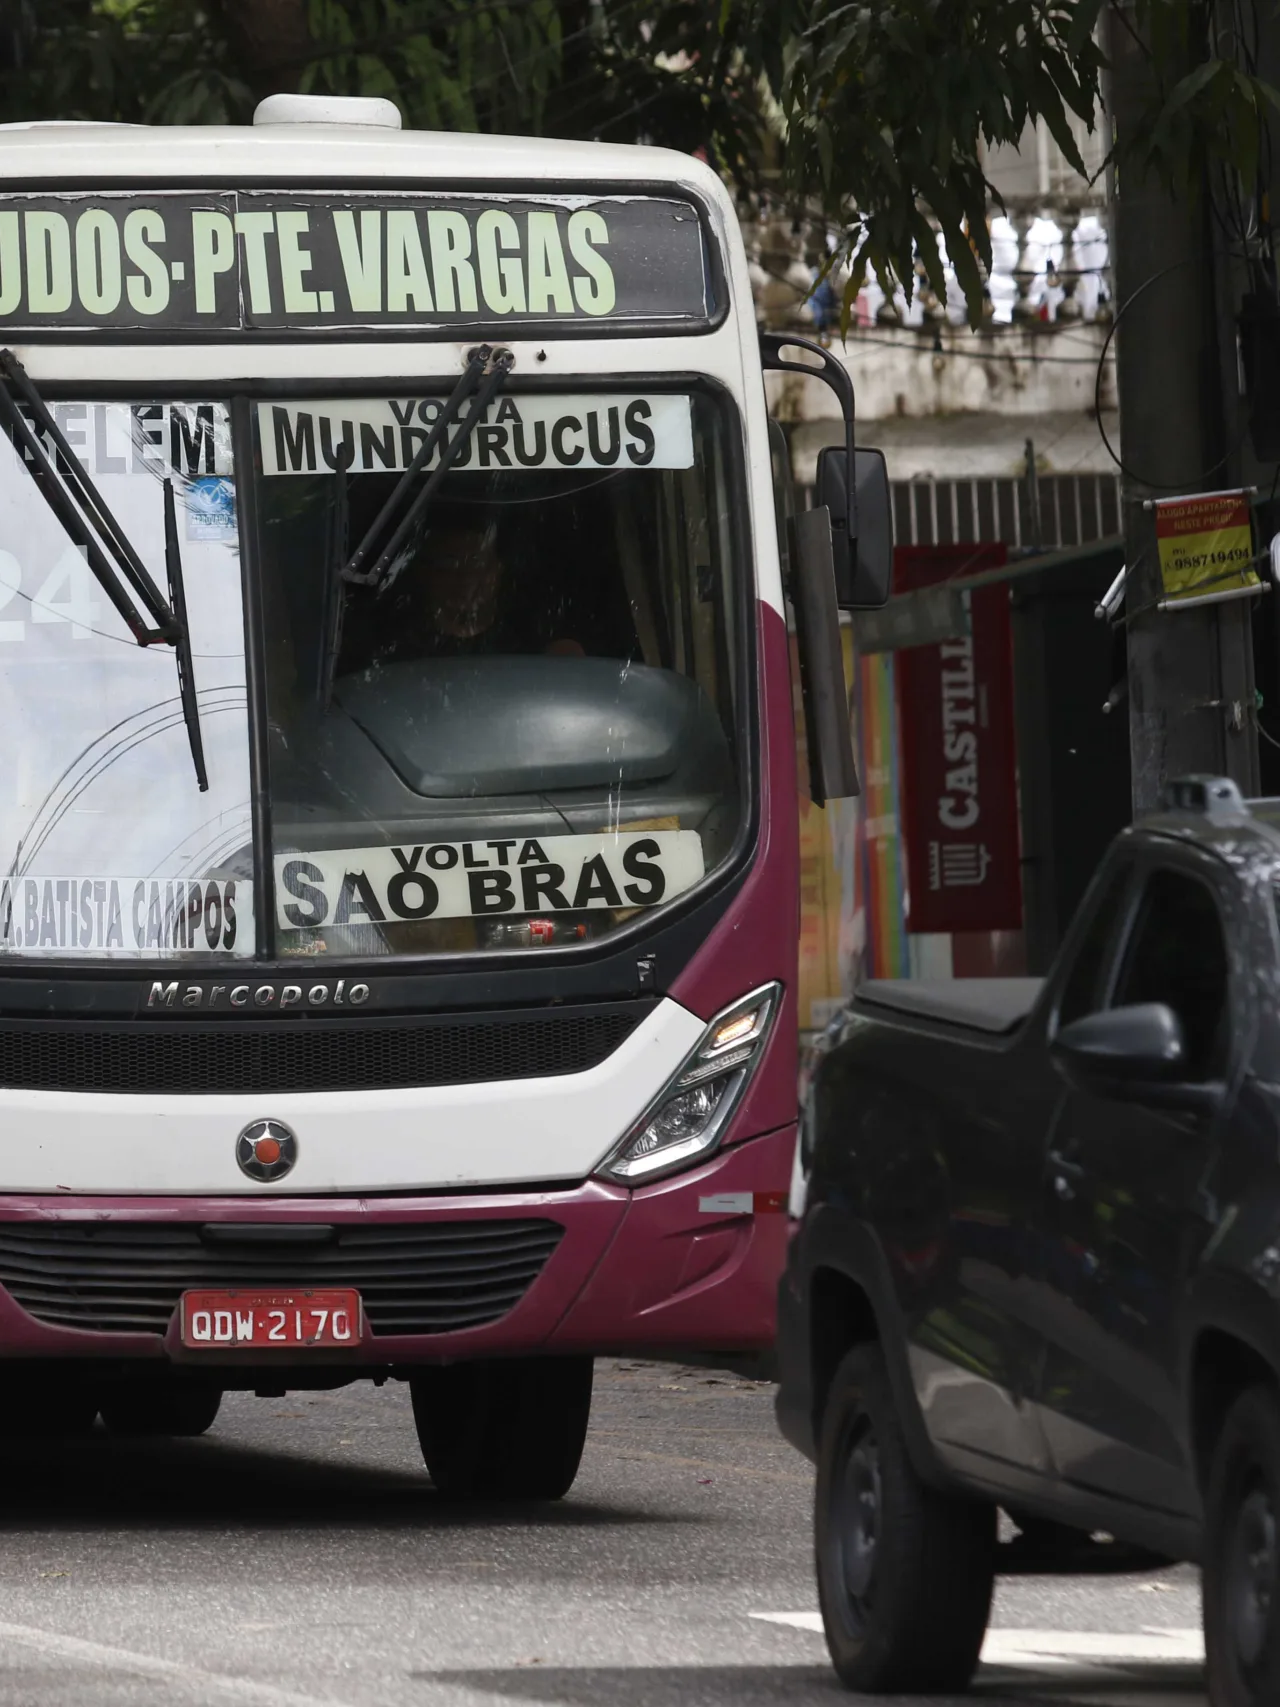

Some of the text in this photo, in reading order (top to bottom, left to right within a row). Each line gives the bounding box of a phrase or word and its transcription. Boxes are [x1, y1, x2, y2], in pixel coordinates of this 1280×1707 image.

[388, 397, 523, 426] VOLTA
[272, 399, 655, 471] MUNDURUCUS
[391, 838, 551, 873] VOLTA
[132, 879, 237, 951] CAMPOS
[146, 980, 370, 1009] Marcopolo
